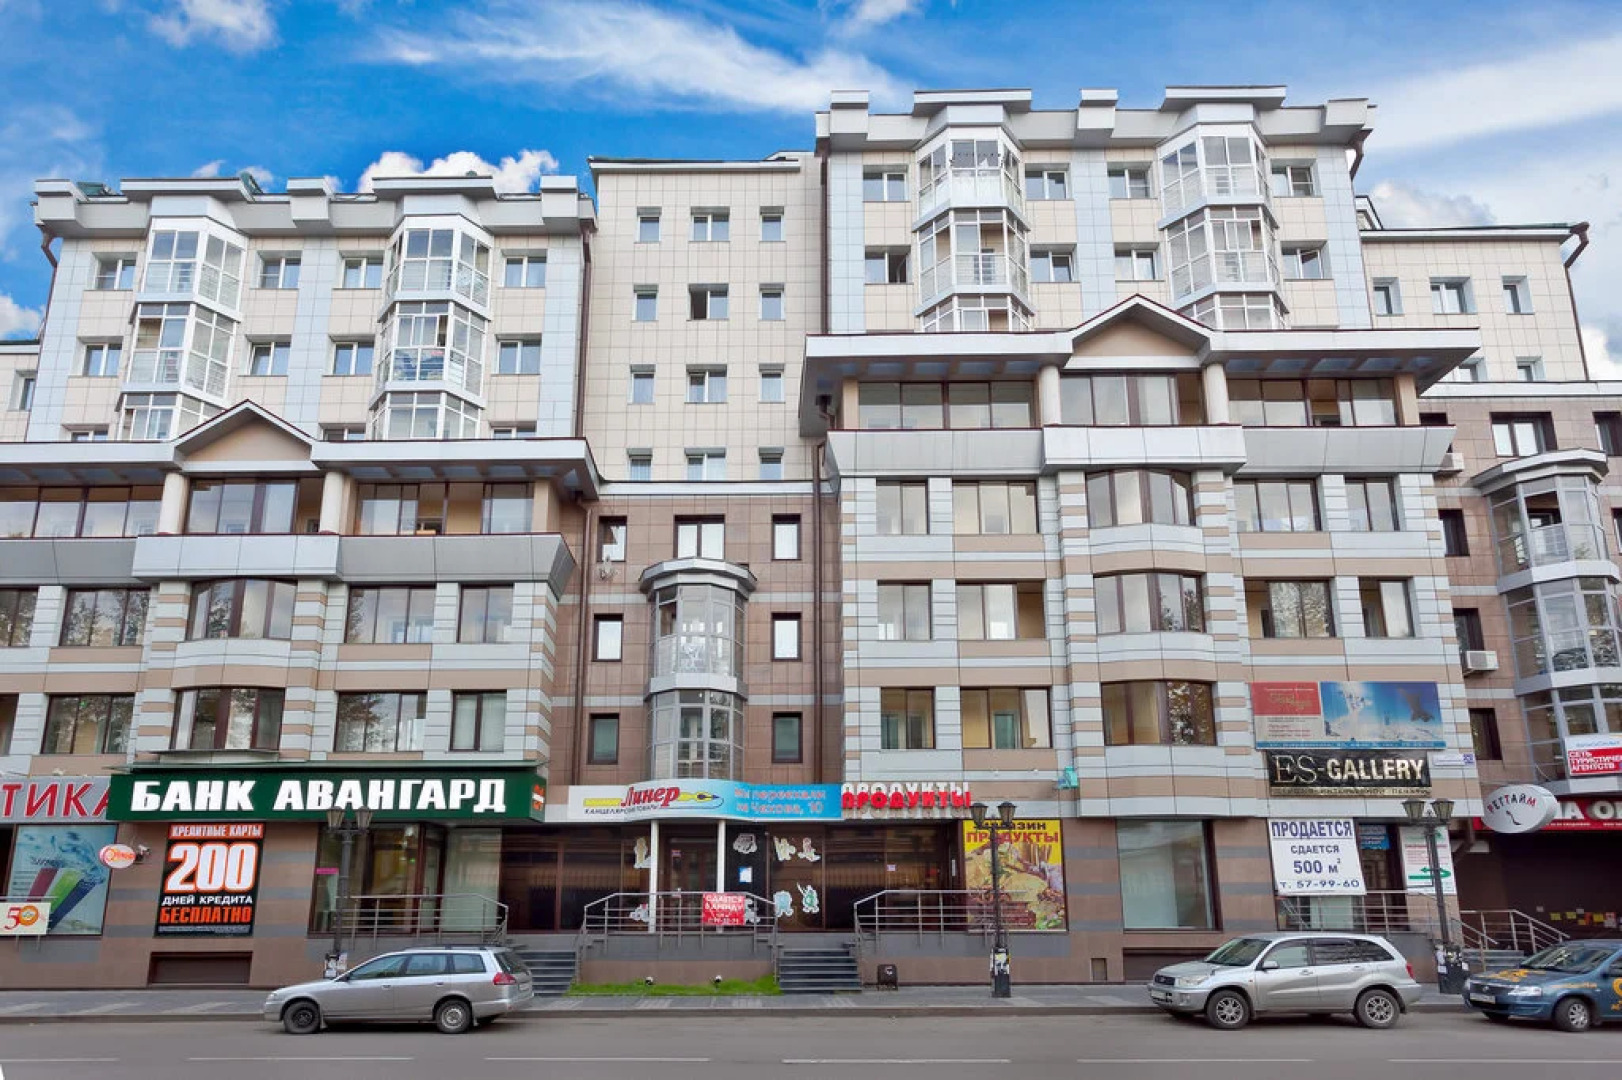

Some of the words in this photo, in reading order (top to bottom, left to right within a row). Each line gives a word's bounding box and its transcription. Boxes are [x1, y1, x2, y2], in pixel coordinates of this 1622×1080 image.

[1272, 754, 1424, 784] ES-GALLERY
[131, 780, 256, 811] БАНК
[272, 779, 506, 812] АВАНГАРД
[621, 787, 681, 806] Линер
[842, 787, 972, 808] ПРОДУКТЫ
[172, 825, 226, 836] КРЕДИТНЫЕ
[229, 825, 261, 836] КАРТЫ
[966, 832, 1059, 842] ПРДУКТЫ
[1272, 821, 1353, 838] ПРОДАЕТСЯ
[1290, 845, 1340, 855] СДАЕТСЯ
[165, 842, 258, 893] 200
[1293, 860, 1323, 874] 500
[1297, 880, 1360, 888] 57-99-60
[162, 895, 195, 906] ДНЕЙ
[199, 895, 253, 904] КРЕДИТА
[160, 906, 252, 923] БЕСПЛАТНО
